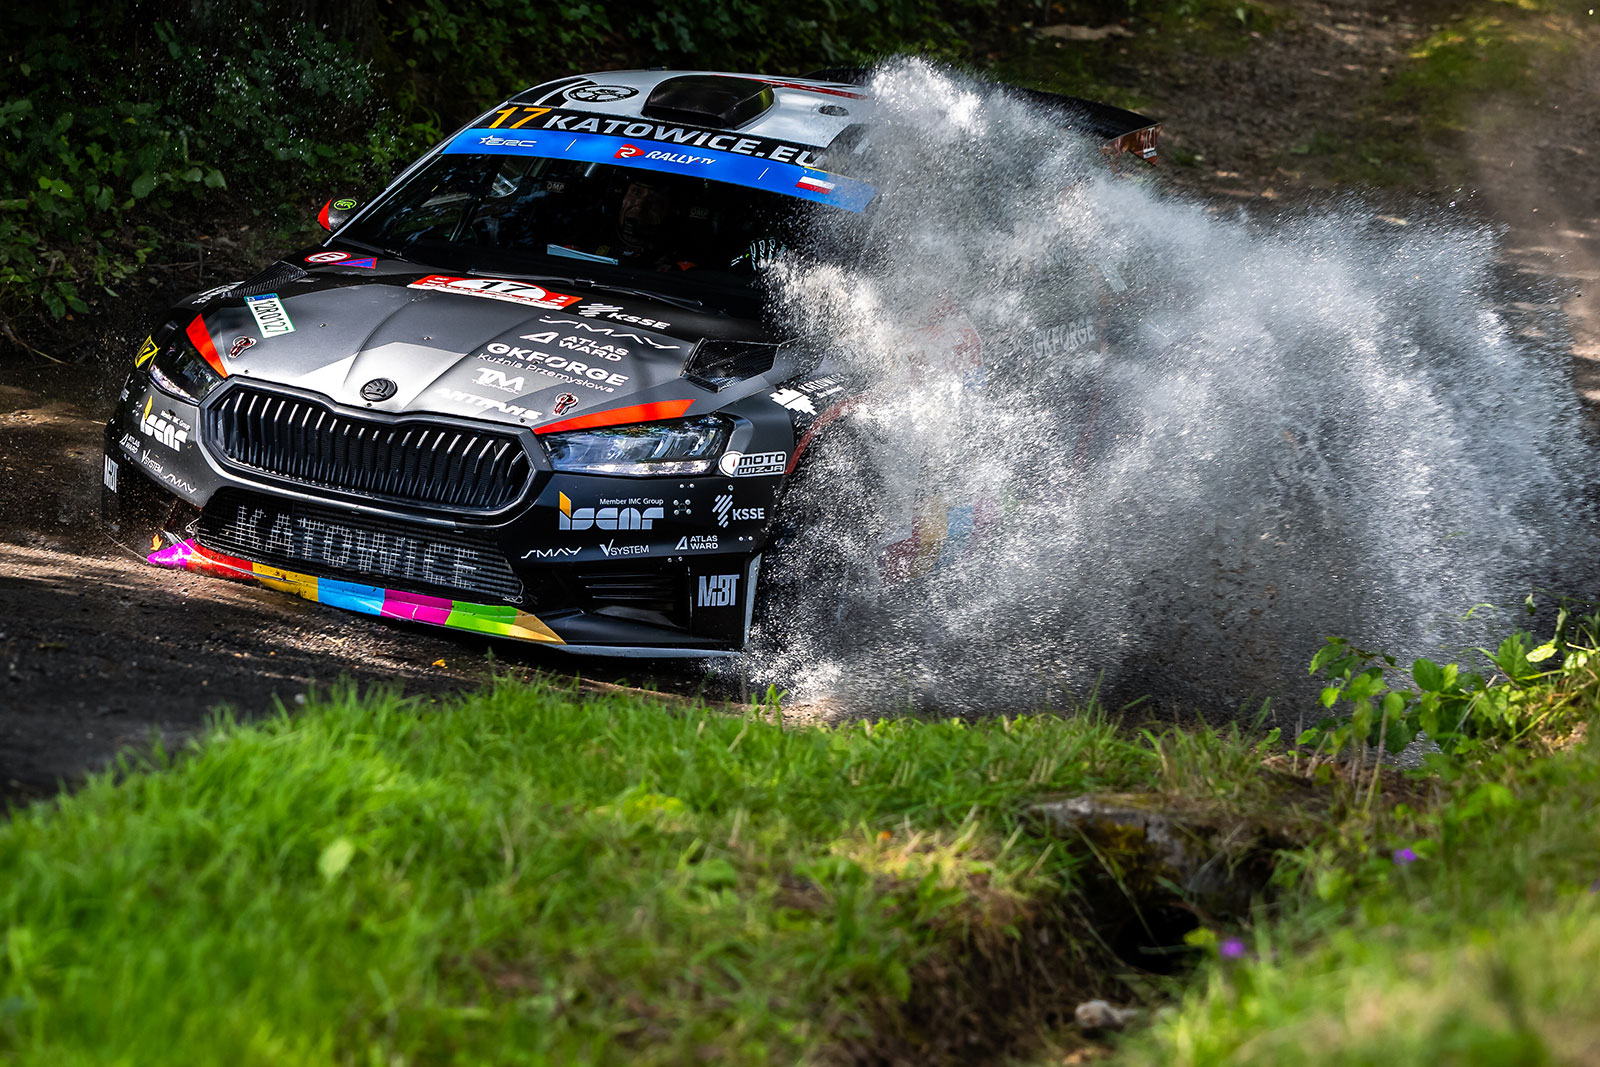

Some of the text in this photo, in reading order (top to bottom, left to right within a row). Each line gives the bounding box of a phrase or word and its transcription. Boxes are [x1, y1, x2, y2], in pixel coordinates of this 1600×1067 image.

[488, 106, 552, 129] 17
[481, 280, 536, 293] 17
[607, 312, 671, 330] KSSE
[558, 341, 622, 361] WARD
[563, 335, 629, 356] ATLAS
[487, 343, 629, 387] GKFORGE
[476, 367, 525, 391] TM
[739, 454, 785, 465] MOTO
[738, 466, 784, 475] WIZJA
[600, 498, 627, 506] Member
[643, 497, 664, 507] Group
[732, 507, 765, 521] KSSE
[521, 546, 582, 559] SMAY
[690, 542, 718, 550] WARD
